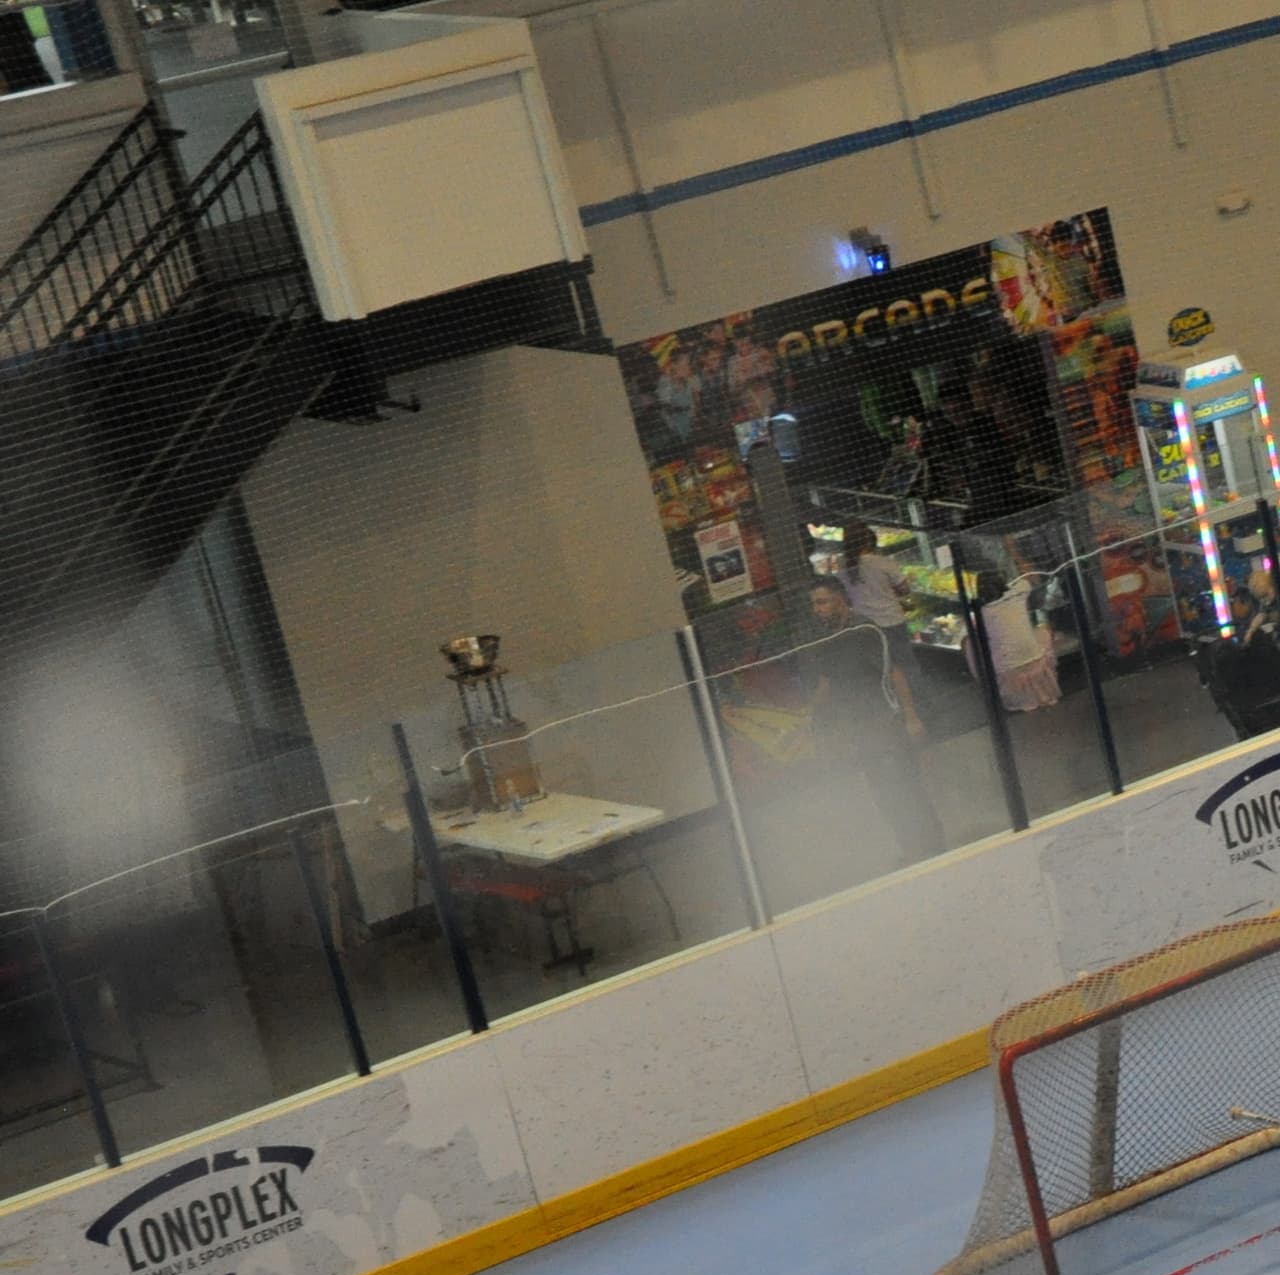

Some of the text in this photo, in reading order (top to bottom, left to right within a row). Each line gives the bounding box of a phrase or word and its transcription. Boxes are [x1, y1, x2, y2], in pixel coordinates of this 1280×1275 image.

[777, 277, 993, 368] ARCADE
[1230, 844, 1264, 865] FAMILY
[119, 1168, 298, 1272] LONGPLEX
[187, 1256, 198, 1270] &
[200, 1236, 250, 1266] SPORTS
[253, 1217, 304, 1244] CENTER
